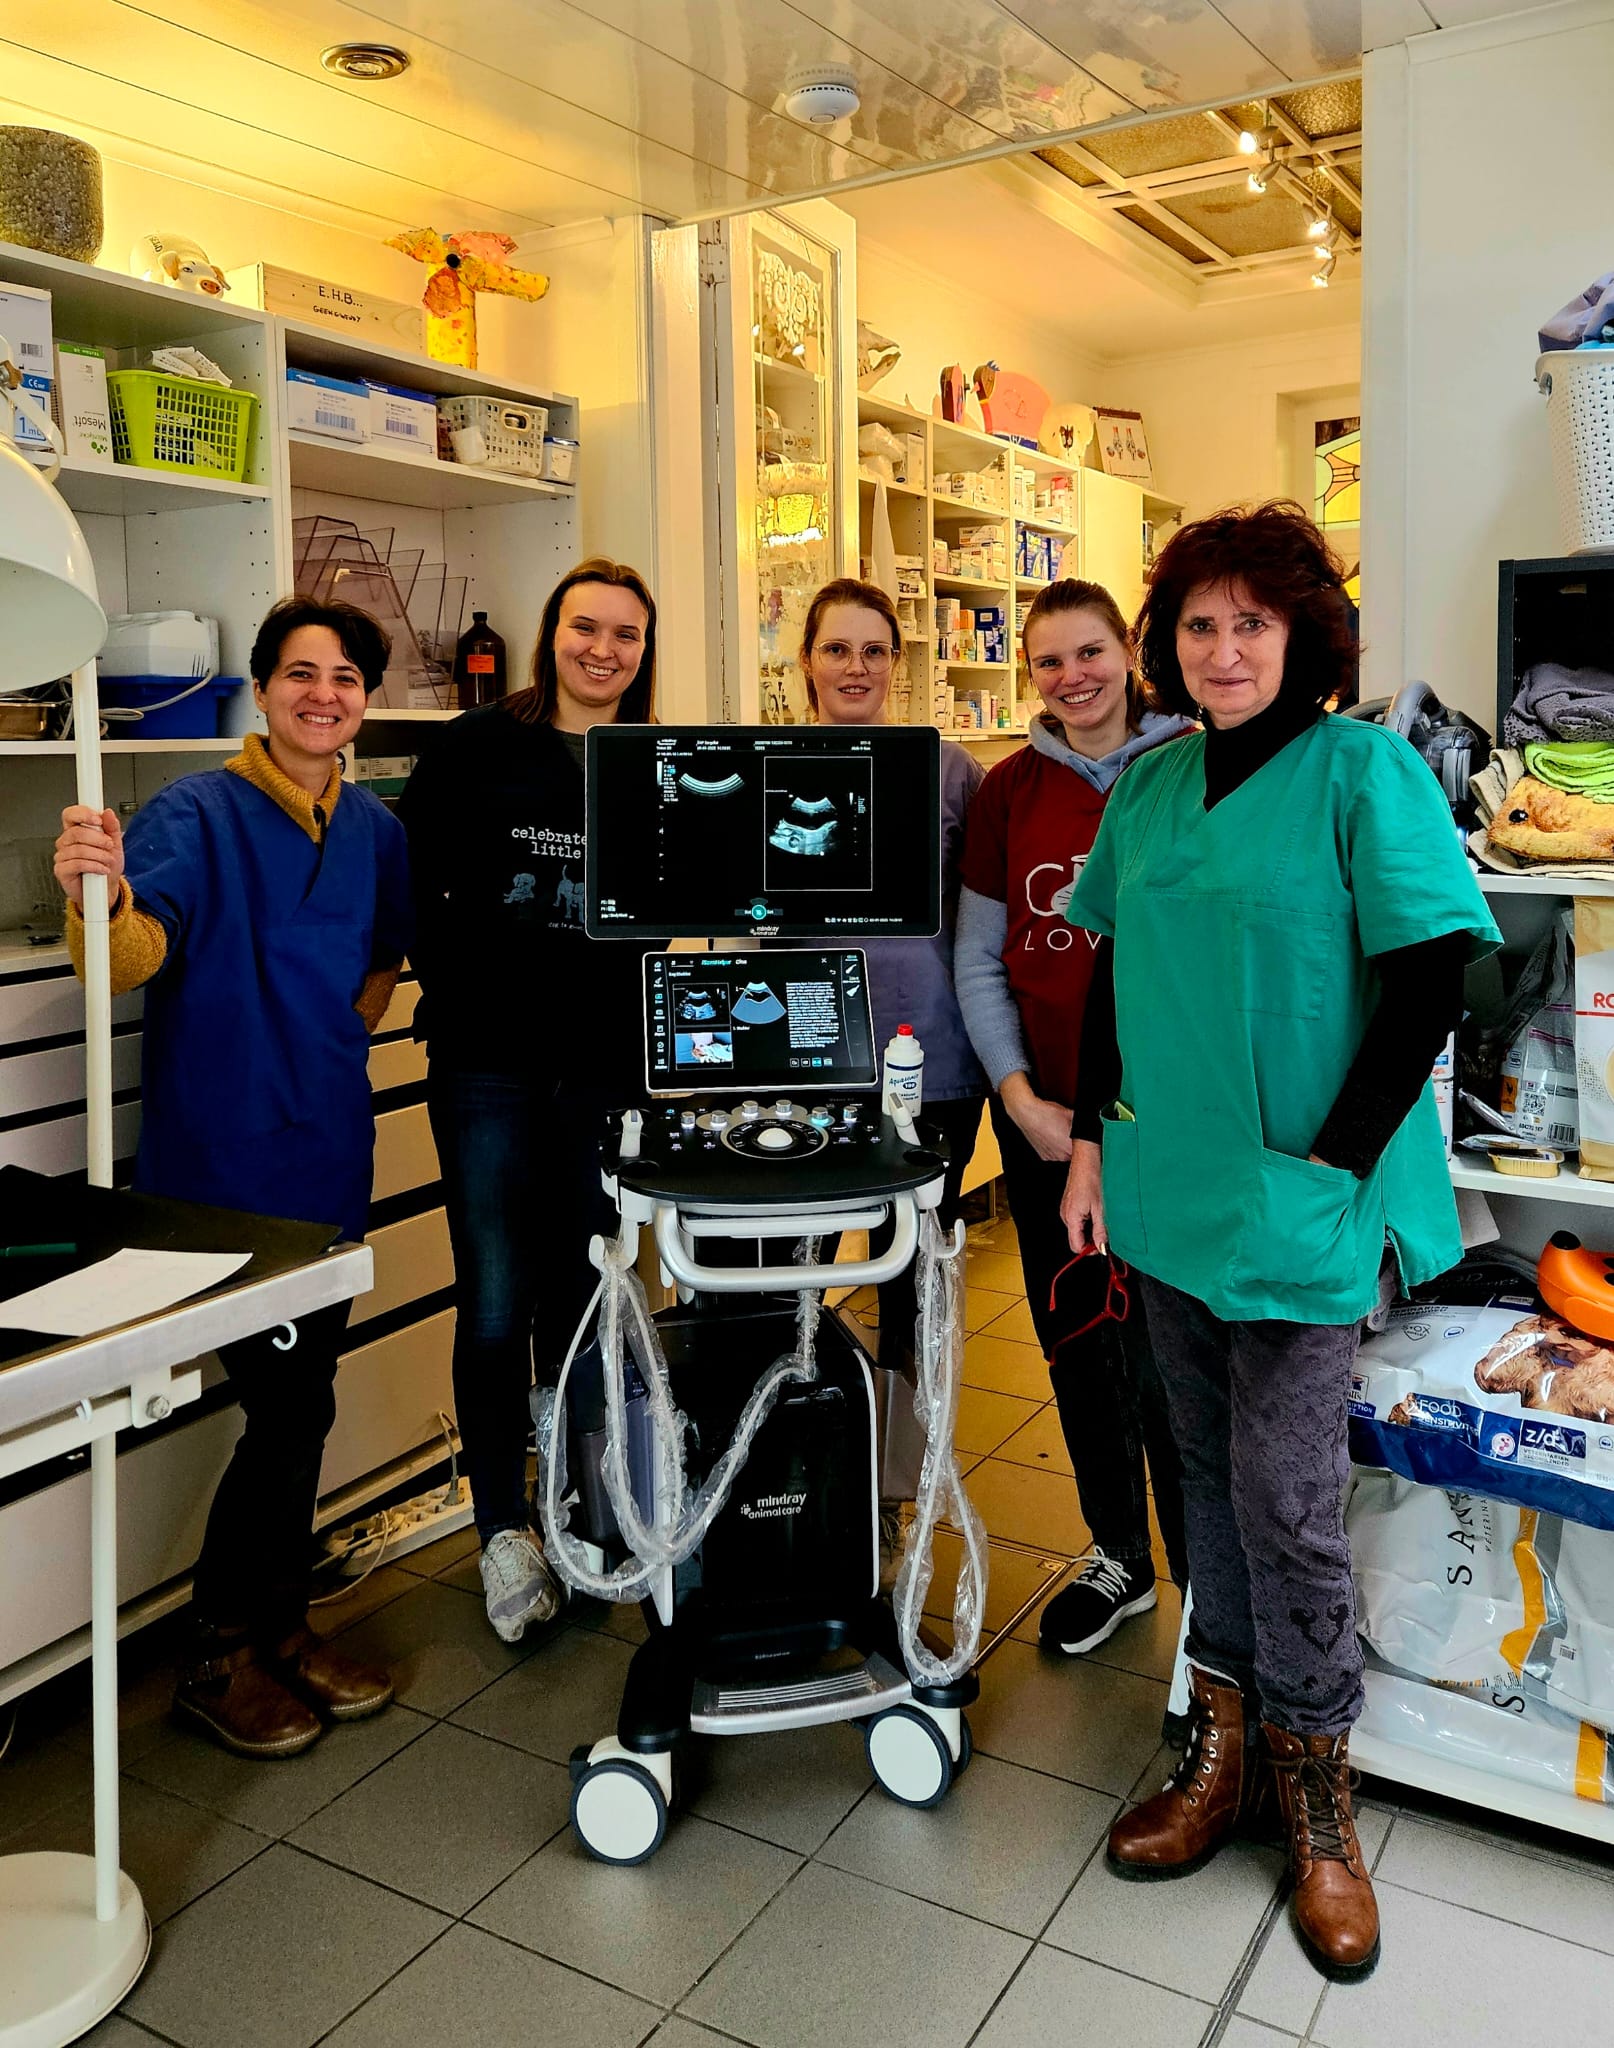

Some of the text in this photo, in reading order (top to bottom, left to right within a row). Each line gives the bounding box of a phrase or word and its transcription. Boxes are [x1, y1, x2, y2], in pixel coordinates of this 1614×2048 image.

[74, 415, 106, 431] Mesoft
[511, 826, 587, 845] celebrate
[531, 841, 581, 859] little
[1420, 1399, 1462, 1417] FOOD
[1525, 1428, 1556, 1447] z/d
[757, 1493, 807, 1508] mindray
